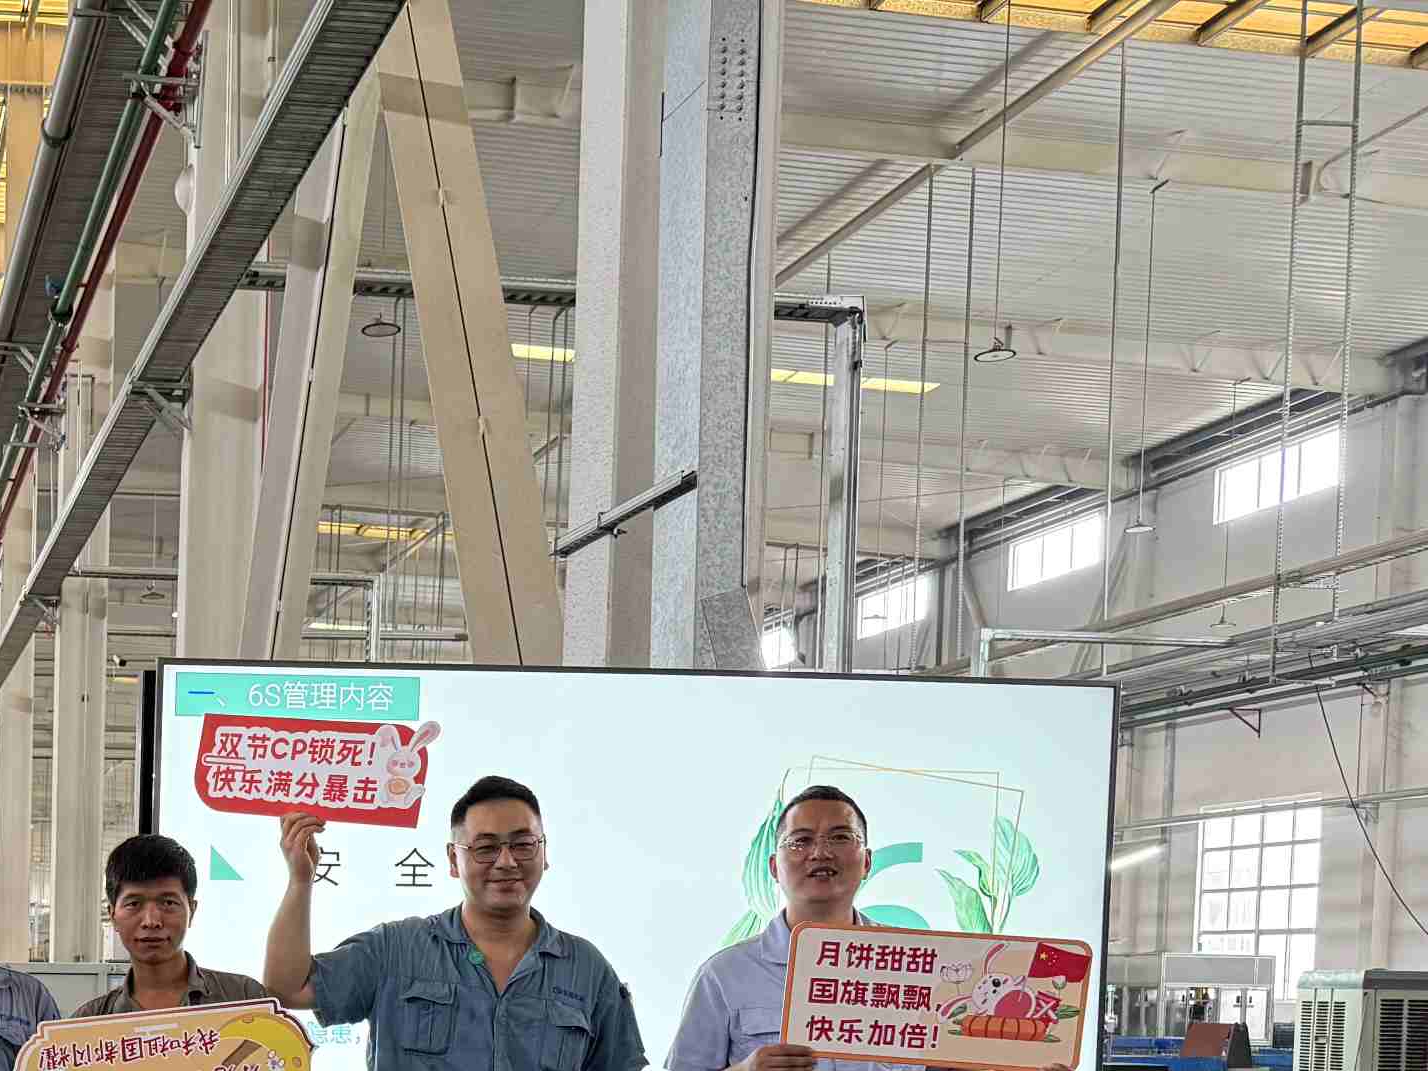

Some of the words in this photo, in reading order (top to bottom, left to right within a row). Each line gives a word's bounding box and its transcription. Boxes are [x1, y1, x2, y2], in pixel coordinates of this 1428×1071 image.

[247, 680, 395, 712] 6S管理内容
[217, 731, 377, 767] 双节CP锁死！
[211, 769, 378, 804] 快乐满分暴击
[815, 940, 939, 975] 月饼甜甜
[807, 977, 943, 1012] 国旗飘飘，
[805, 1014, 939, 1050] 快乐加倍！
